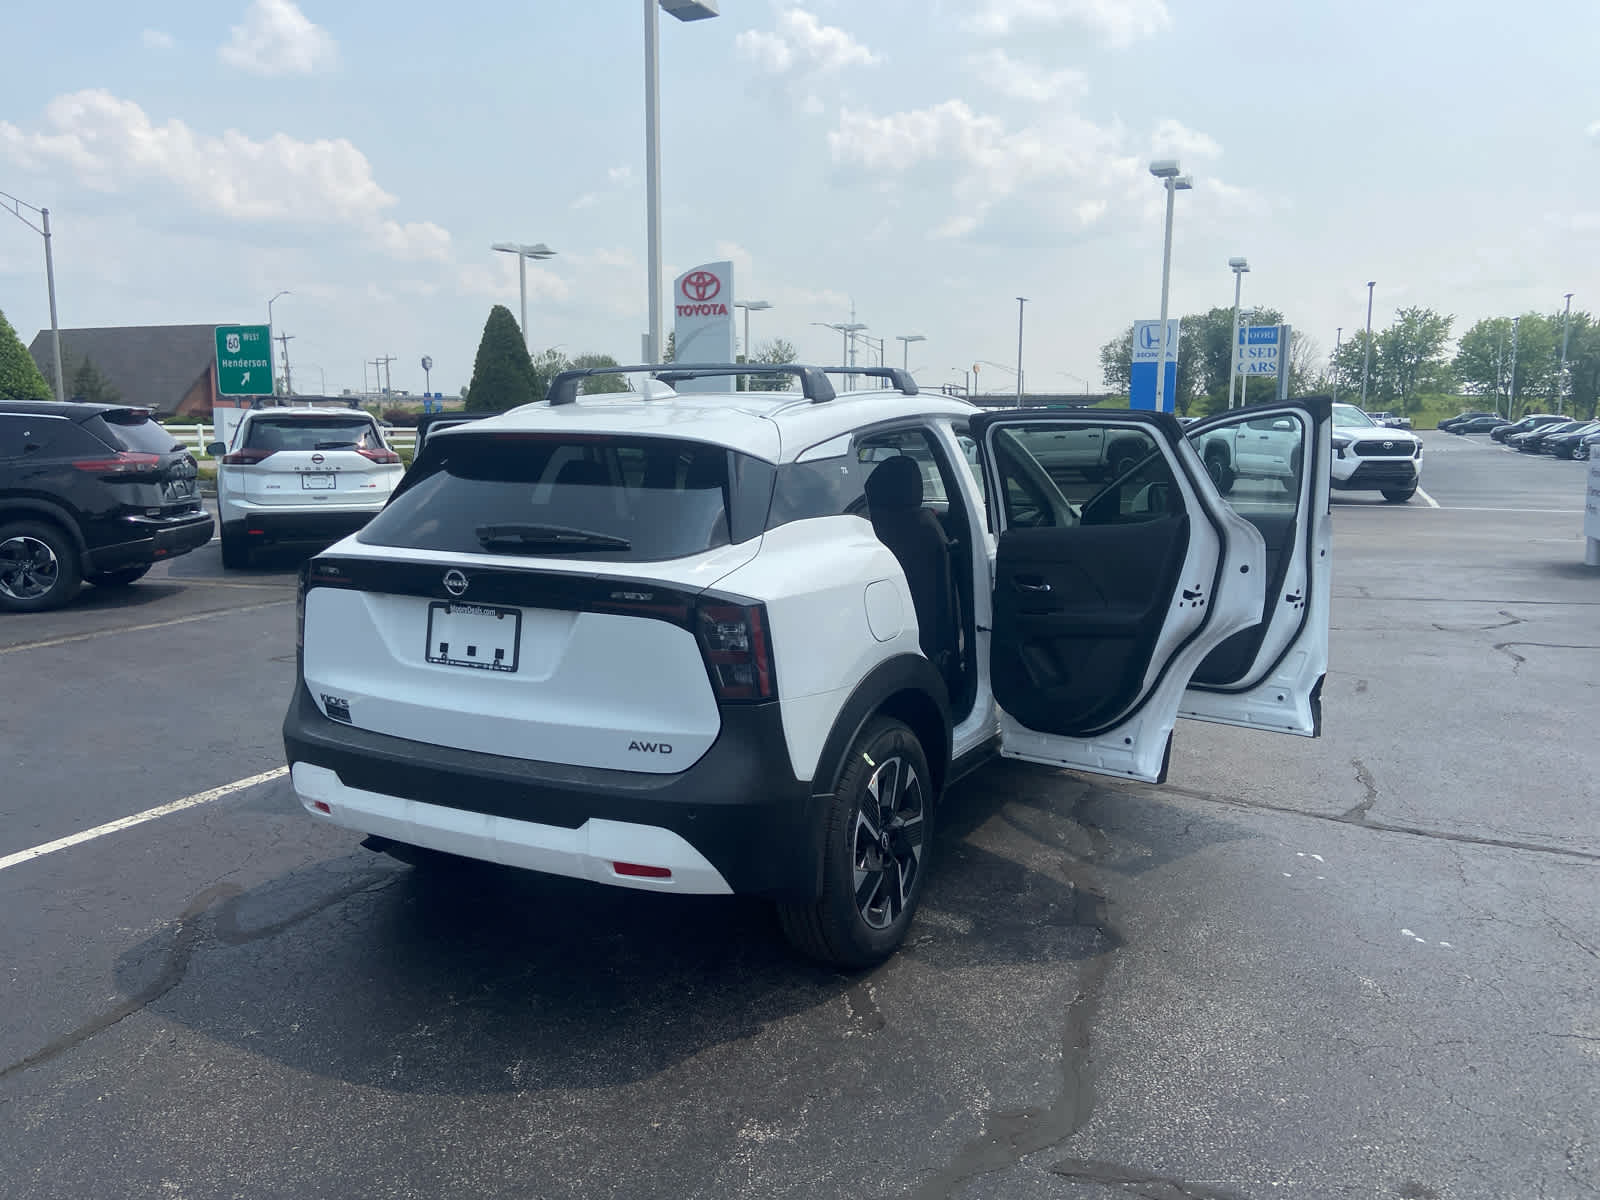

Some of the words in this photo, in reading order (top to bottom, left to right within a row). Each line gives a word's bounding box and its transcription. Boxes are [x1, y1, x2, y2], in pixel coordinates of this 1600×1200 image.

[676, 304, 728, 317] TOYOTA
[228, 338, 239, 349] 60
[222, 359, 267, 368] Henderson
[1237, 361, 1276, 373] CARS
[628, 741, 673, 754] AWD
